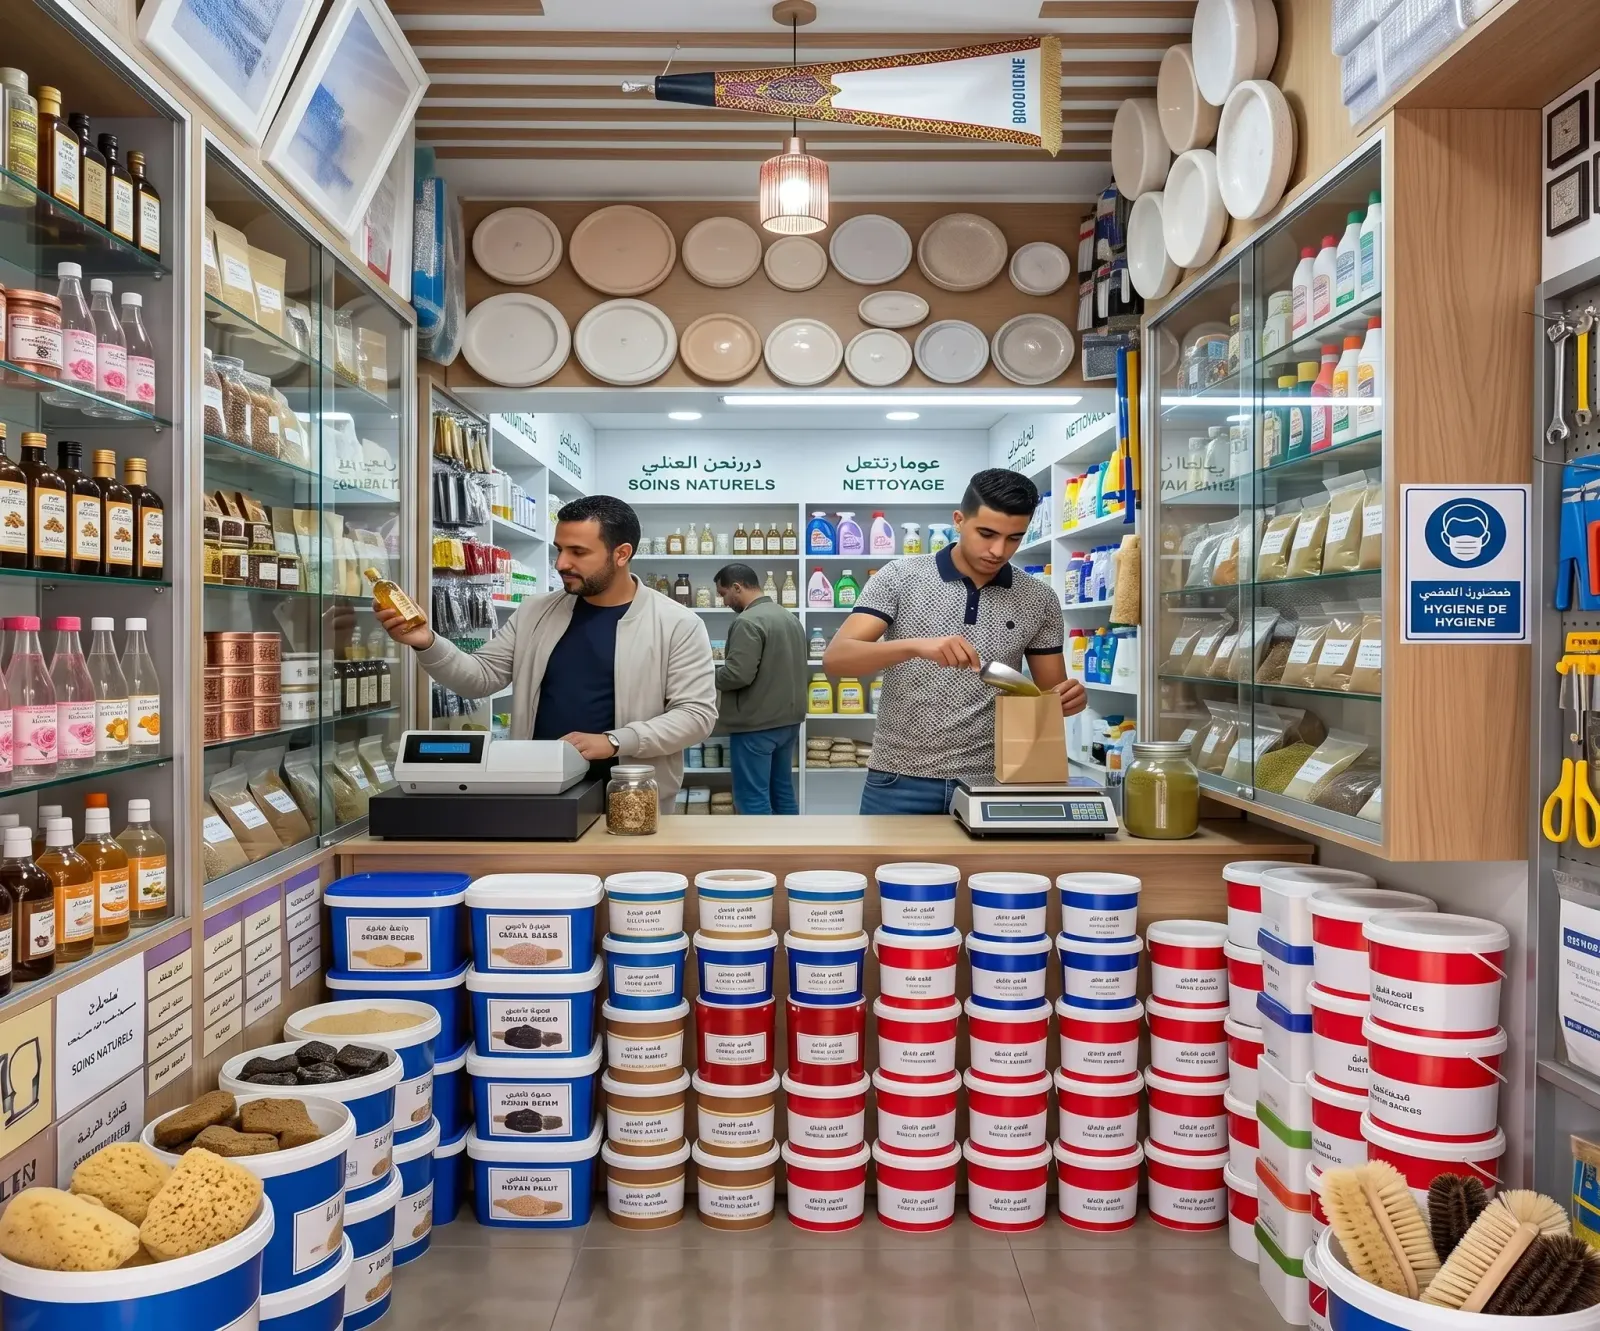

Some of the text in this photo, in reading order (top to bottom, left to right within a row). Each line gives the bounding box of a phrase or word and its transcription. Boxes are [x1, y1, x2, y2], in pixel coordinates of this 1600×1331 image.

[628, 479, 776, 491] SOINS NATURELS
[843, 479, 945, 491] NETTOYAGE
[1424, 604, 1507, 614] HYGIENE DE
[1435, 617, 1496, 627] HYGIENE
[72, 1029, 133, 1076] SOINS NATURELS
